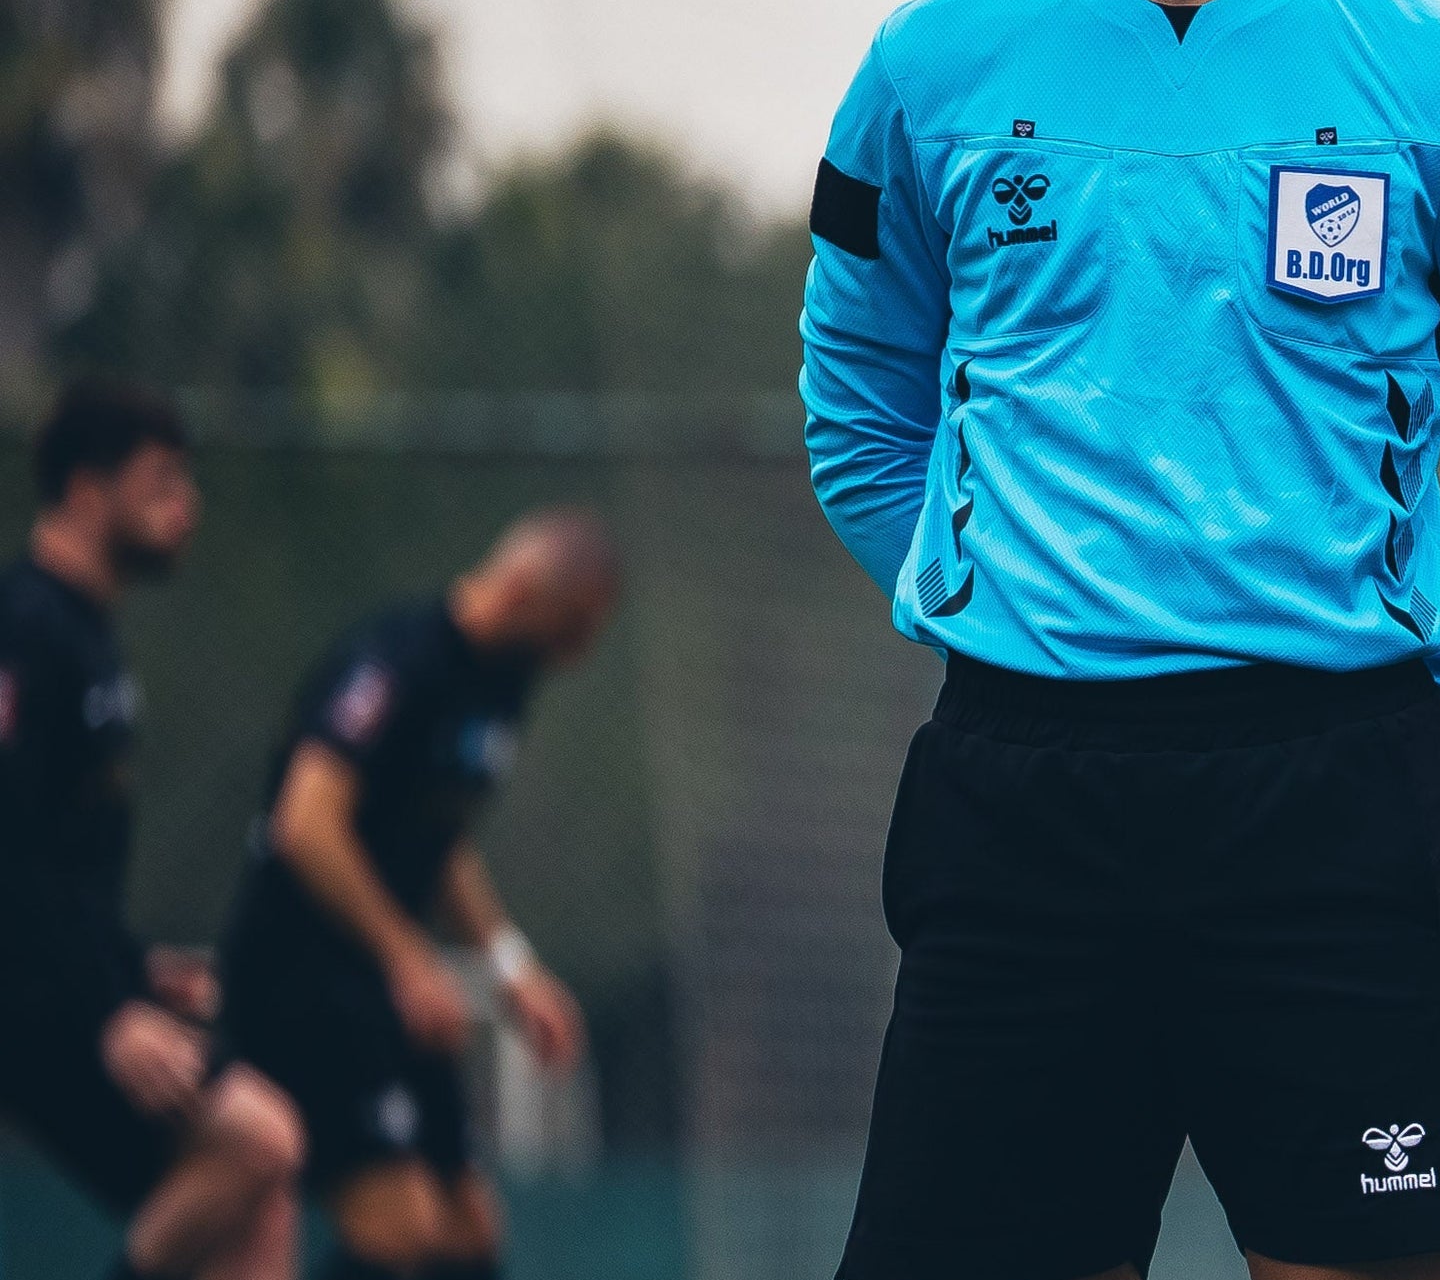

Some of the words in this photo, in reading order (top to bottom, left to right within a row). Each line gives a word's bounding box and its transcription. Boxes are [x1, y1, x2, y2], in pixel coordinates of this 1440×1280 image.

[1311, 192, 1350, 217] WORLD
[1286, 249, 1371, 288] B.D.Org
[1360, 1166, 1436, 1194] hummel
